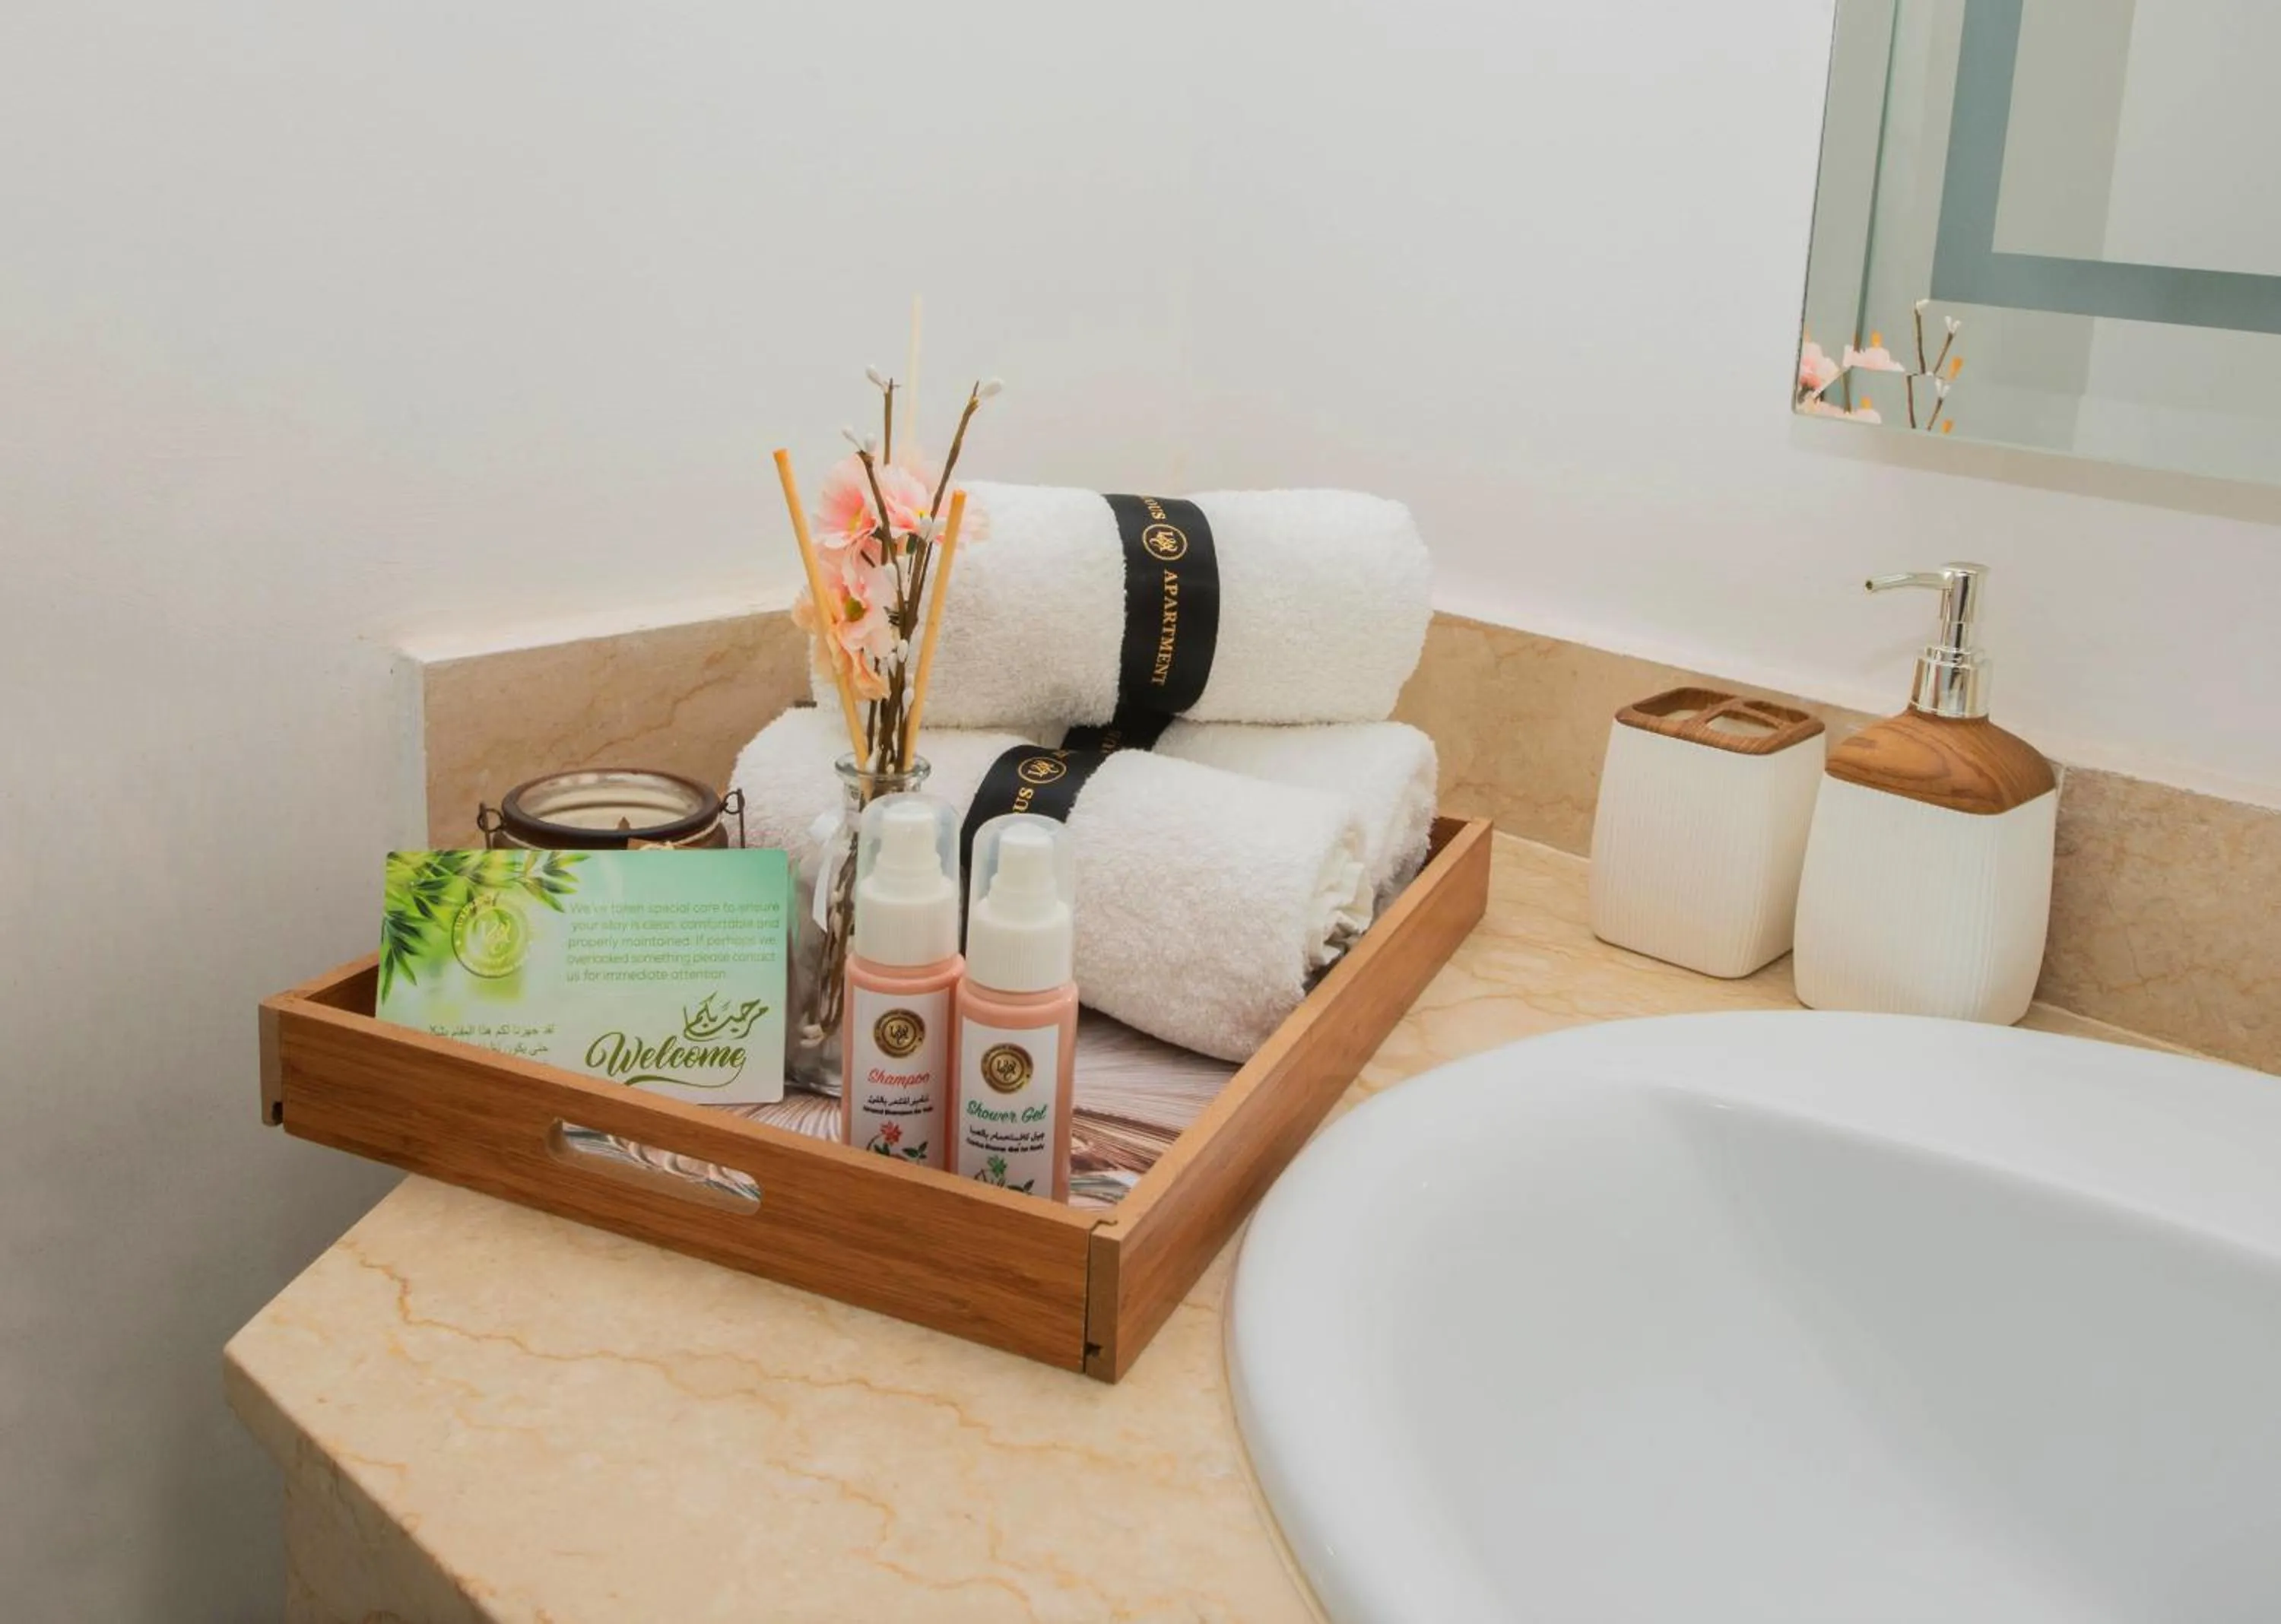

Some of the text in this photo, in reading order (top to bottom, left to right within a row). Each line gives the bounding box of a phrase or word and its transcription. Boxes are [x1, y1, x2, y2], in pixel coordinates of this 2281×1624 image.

[1151, 569, 1178, 686] APARTMENT
[693, 902, 720, 913] care
[722, 902, 735, 913] to
[570, 921, 599, 932] your
[568, 936, 618, 949] properly
[696, 934, 704, 946] If
[583, 969, 600, 981] for
[602, 969, 668, 982] immediate
[585, 1031, 747, 1087] Welcome
[868, 1067, 930, 1089] Shampoo
[966, 1099, 1048, 1124] Shower Gel
